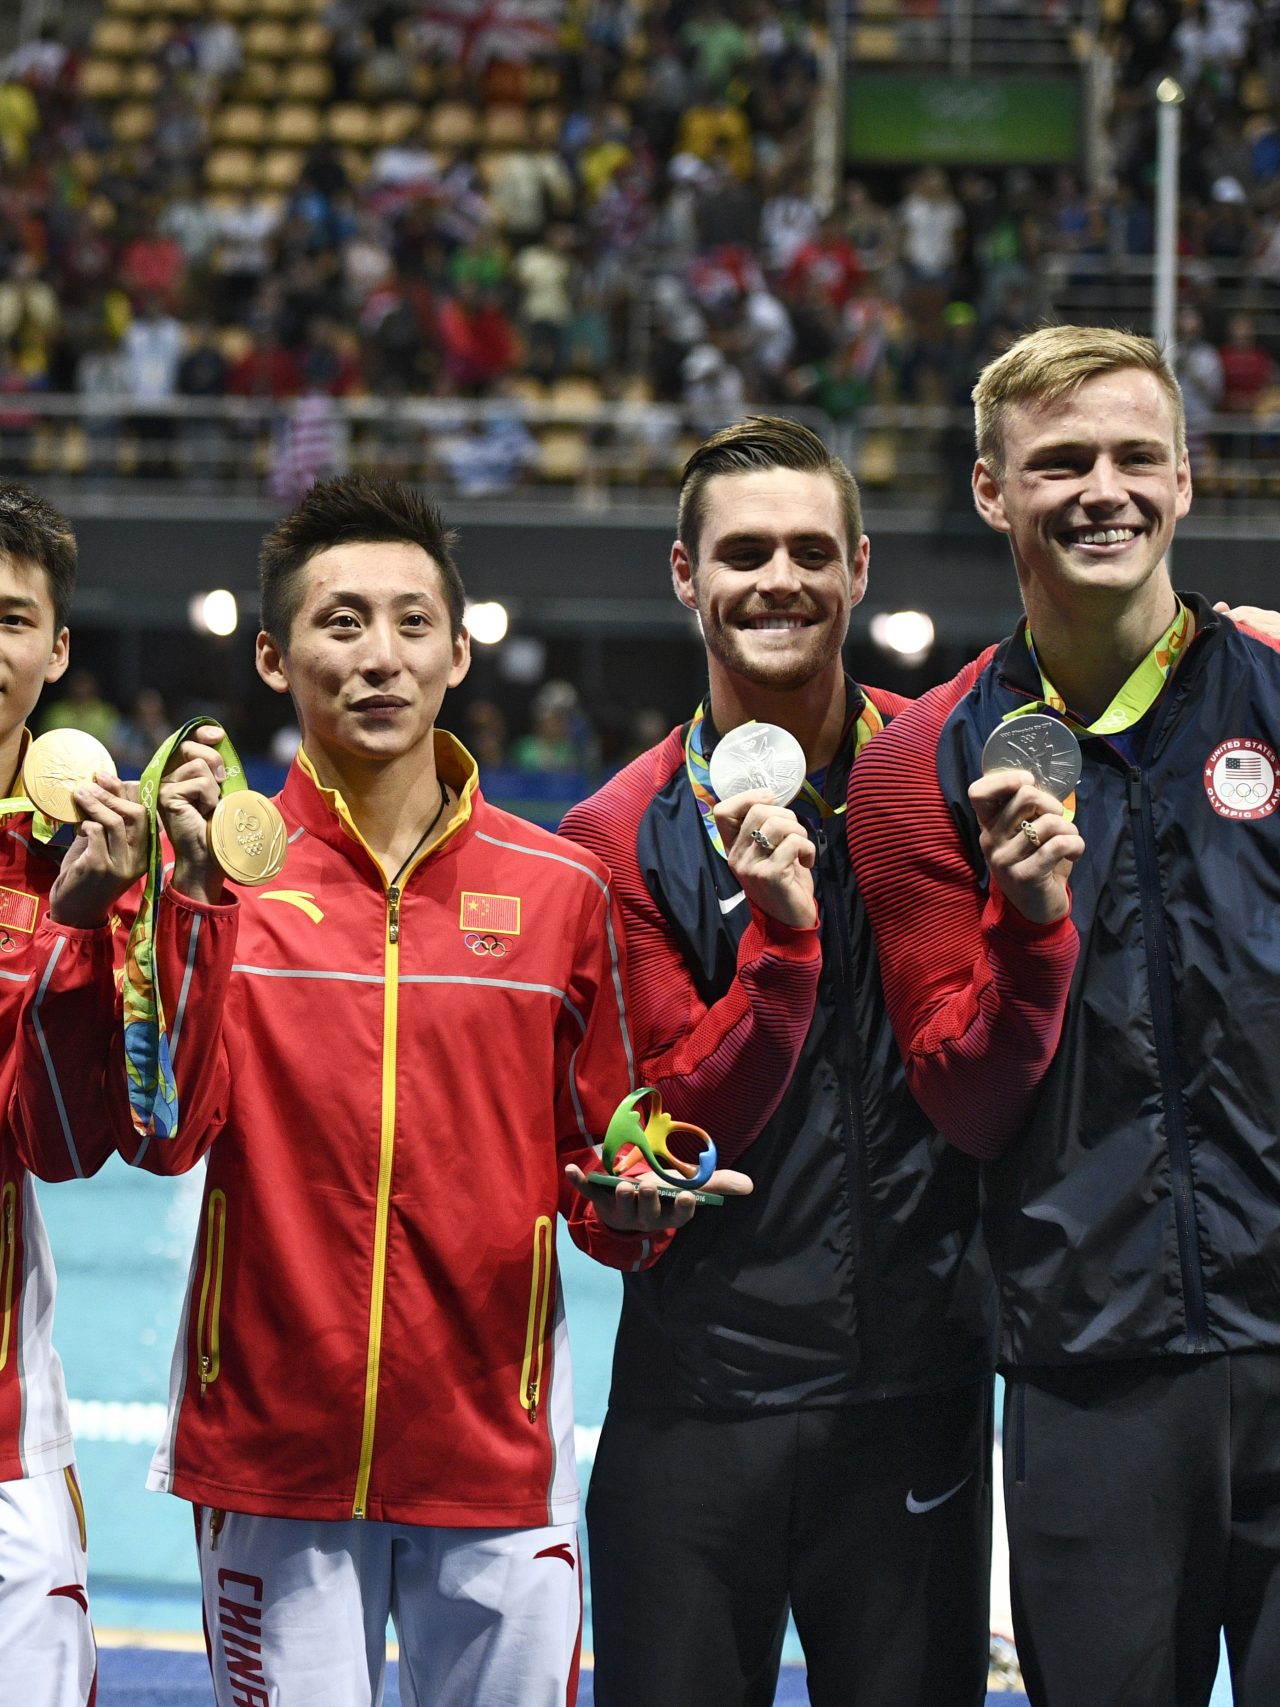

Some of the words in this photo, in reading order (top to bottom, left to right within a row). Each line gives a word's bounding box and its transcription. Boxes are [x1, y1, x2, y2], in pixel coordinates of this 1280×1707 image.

[1210, 740, 1241, 762] UNITED
[1244, 741, 1277, 762] STATES
[1207, 787, 1252, 818] OLYMPIC
[1258, 788, 1280, 814] TEAM
